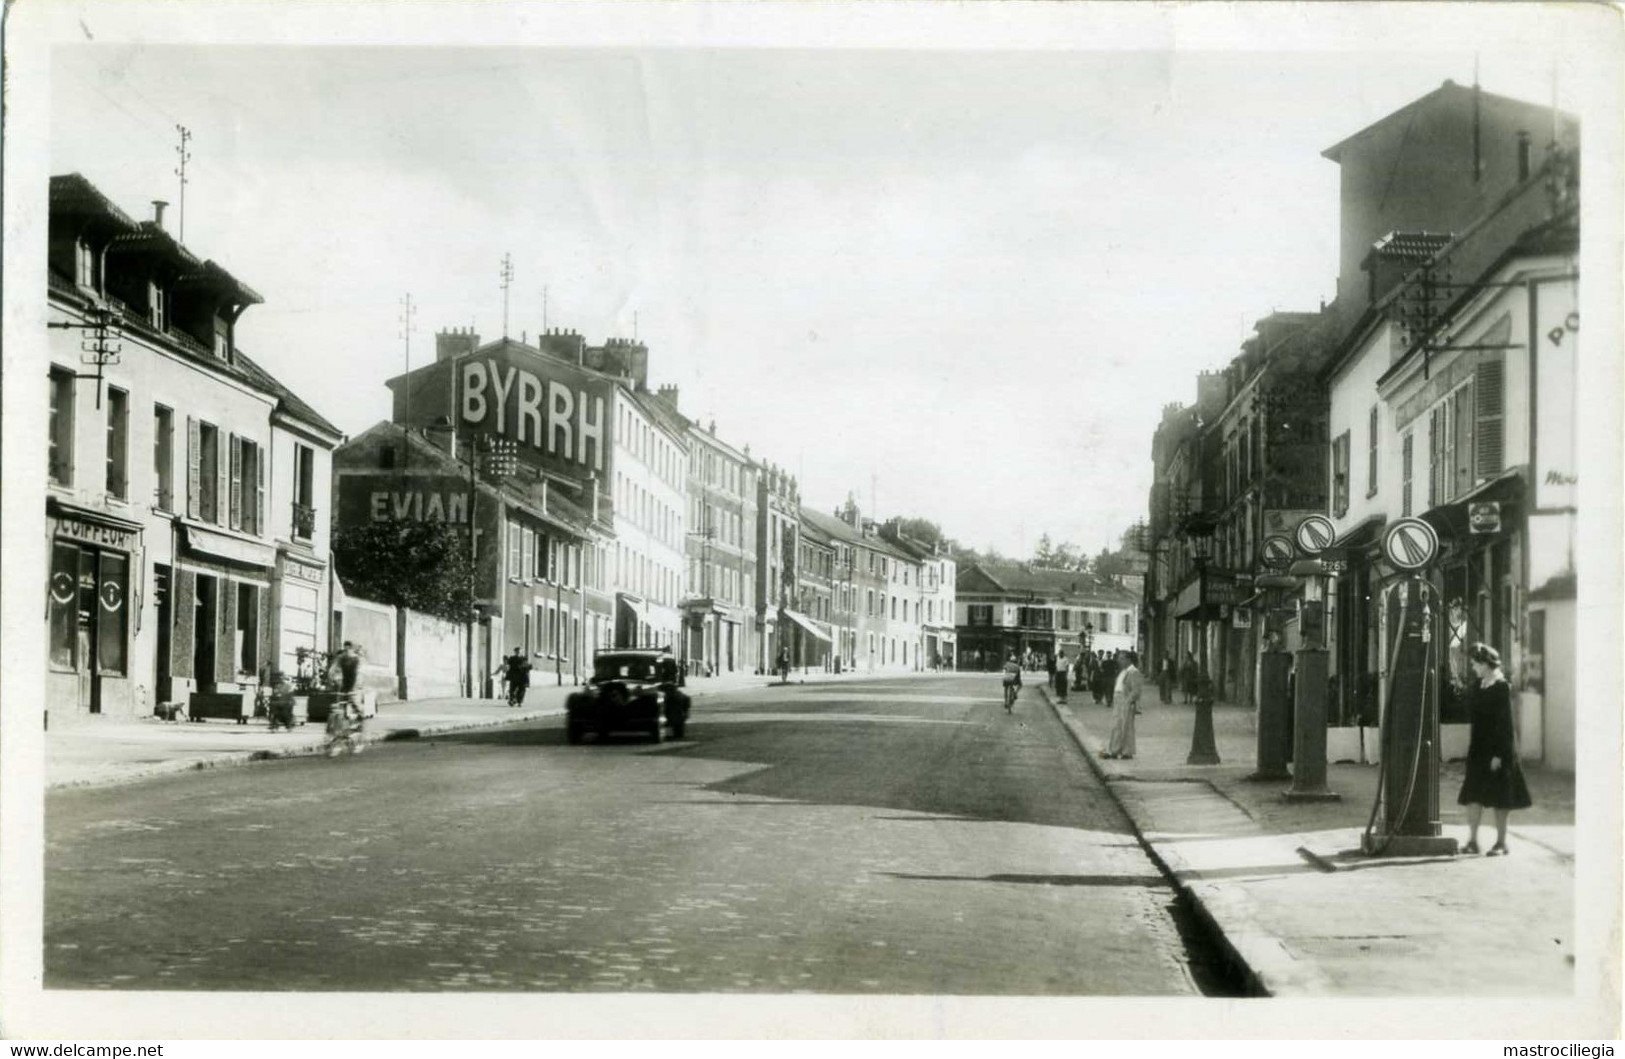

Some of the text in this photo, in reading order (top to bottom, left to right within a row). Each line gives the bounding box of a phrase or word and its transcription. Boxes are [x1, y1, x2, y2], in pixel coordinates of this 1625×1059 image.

[462, 359, 604, 471] BYRRH
[370, 491, 469, 523] EVIAN
[61, 518, 126, 548] COIFFEUR
